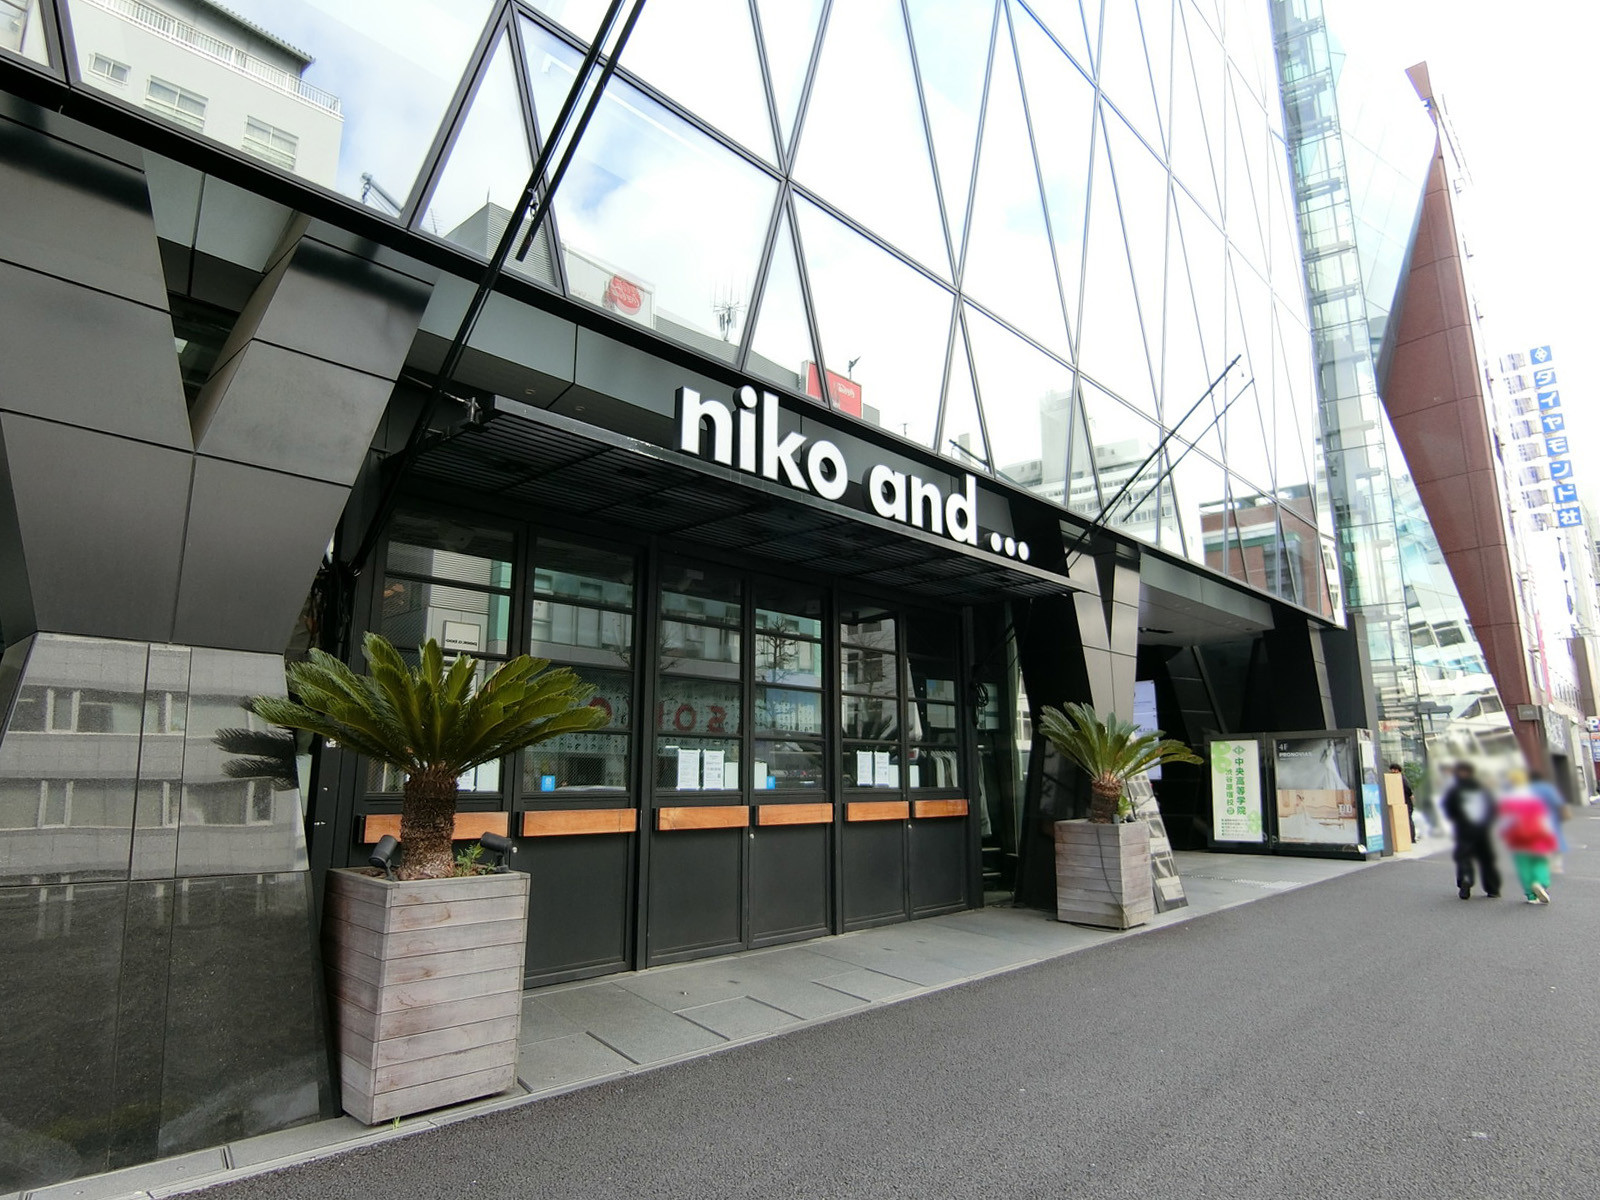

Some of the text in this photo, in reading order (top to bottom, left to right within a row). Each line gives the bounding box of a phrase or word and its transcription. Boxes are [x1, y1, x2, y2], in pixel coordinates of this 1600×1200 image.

[679, 385, 849, 501] niko
[866, 473, 978, 547] and
[1534, 368, 1581, 526] ダイヤモンド社
[1234, 757, 1247, 816] 中央高等学院
